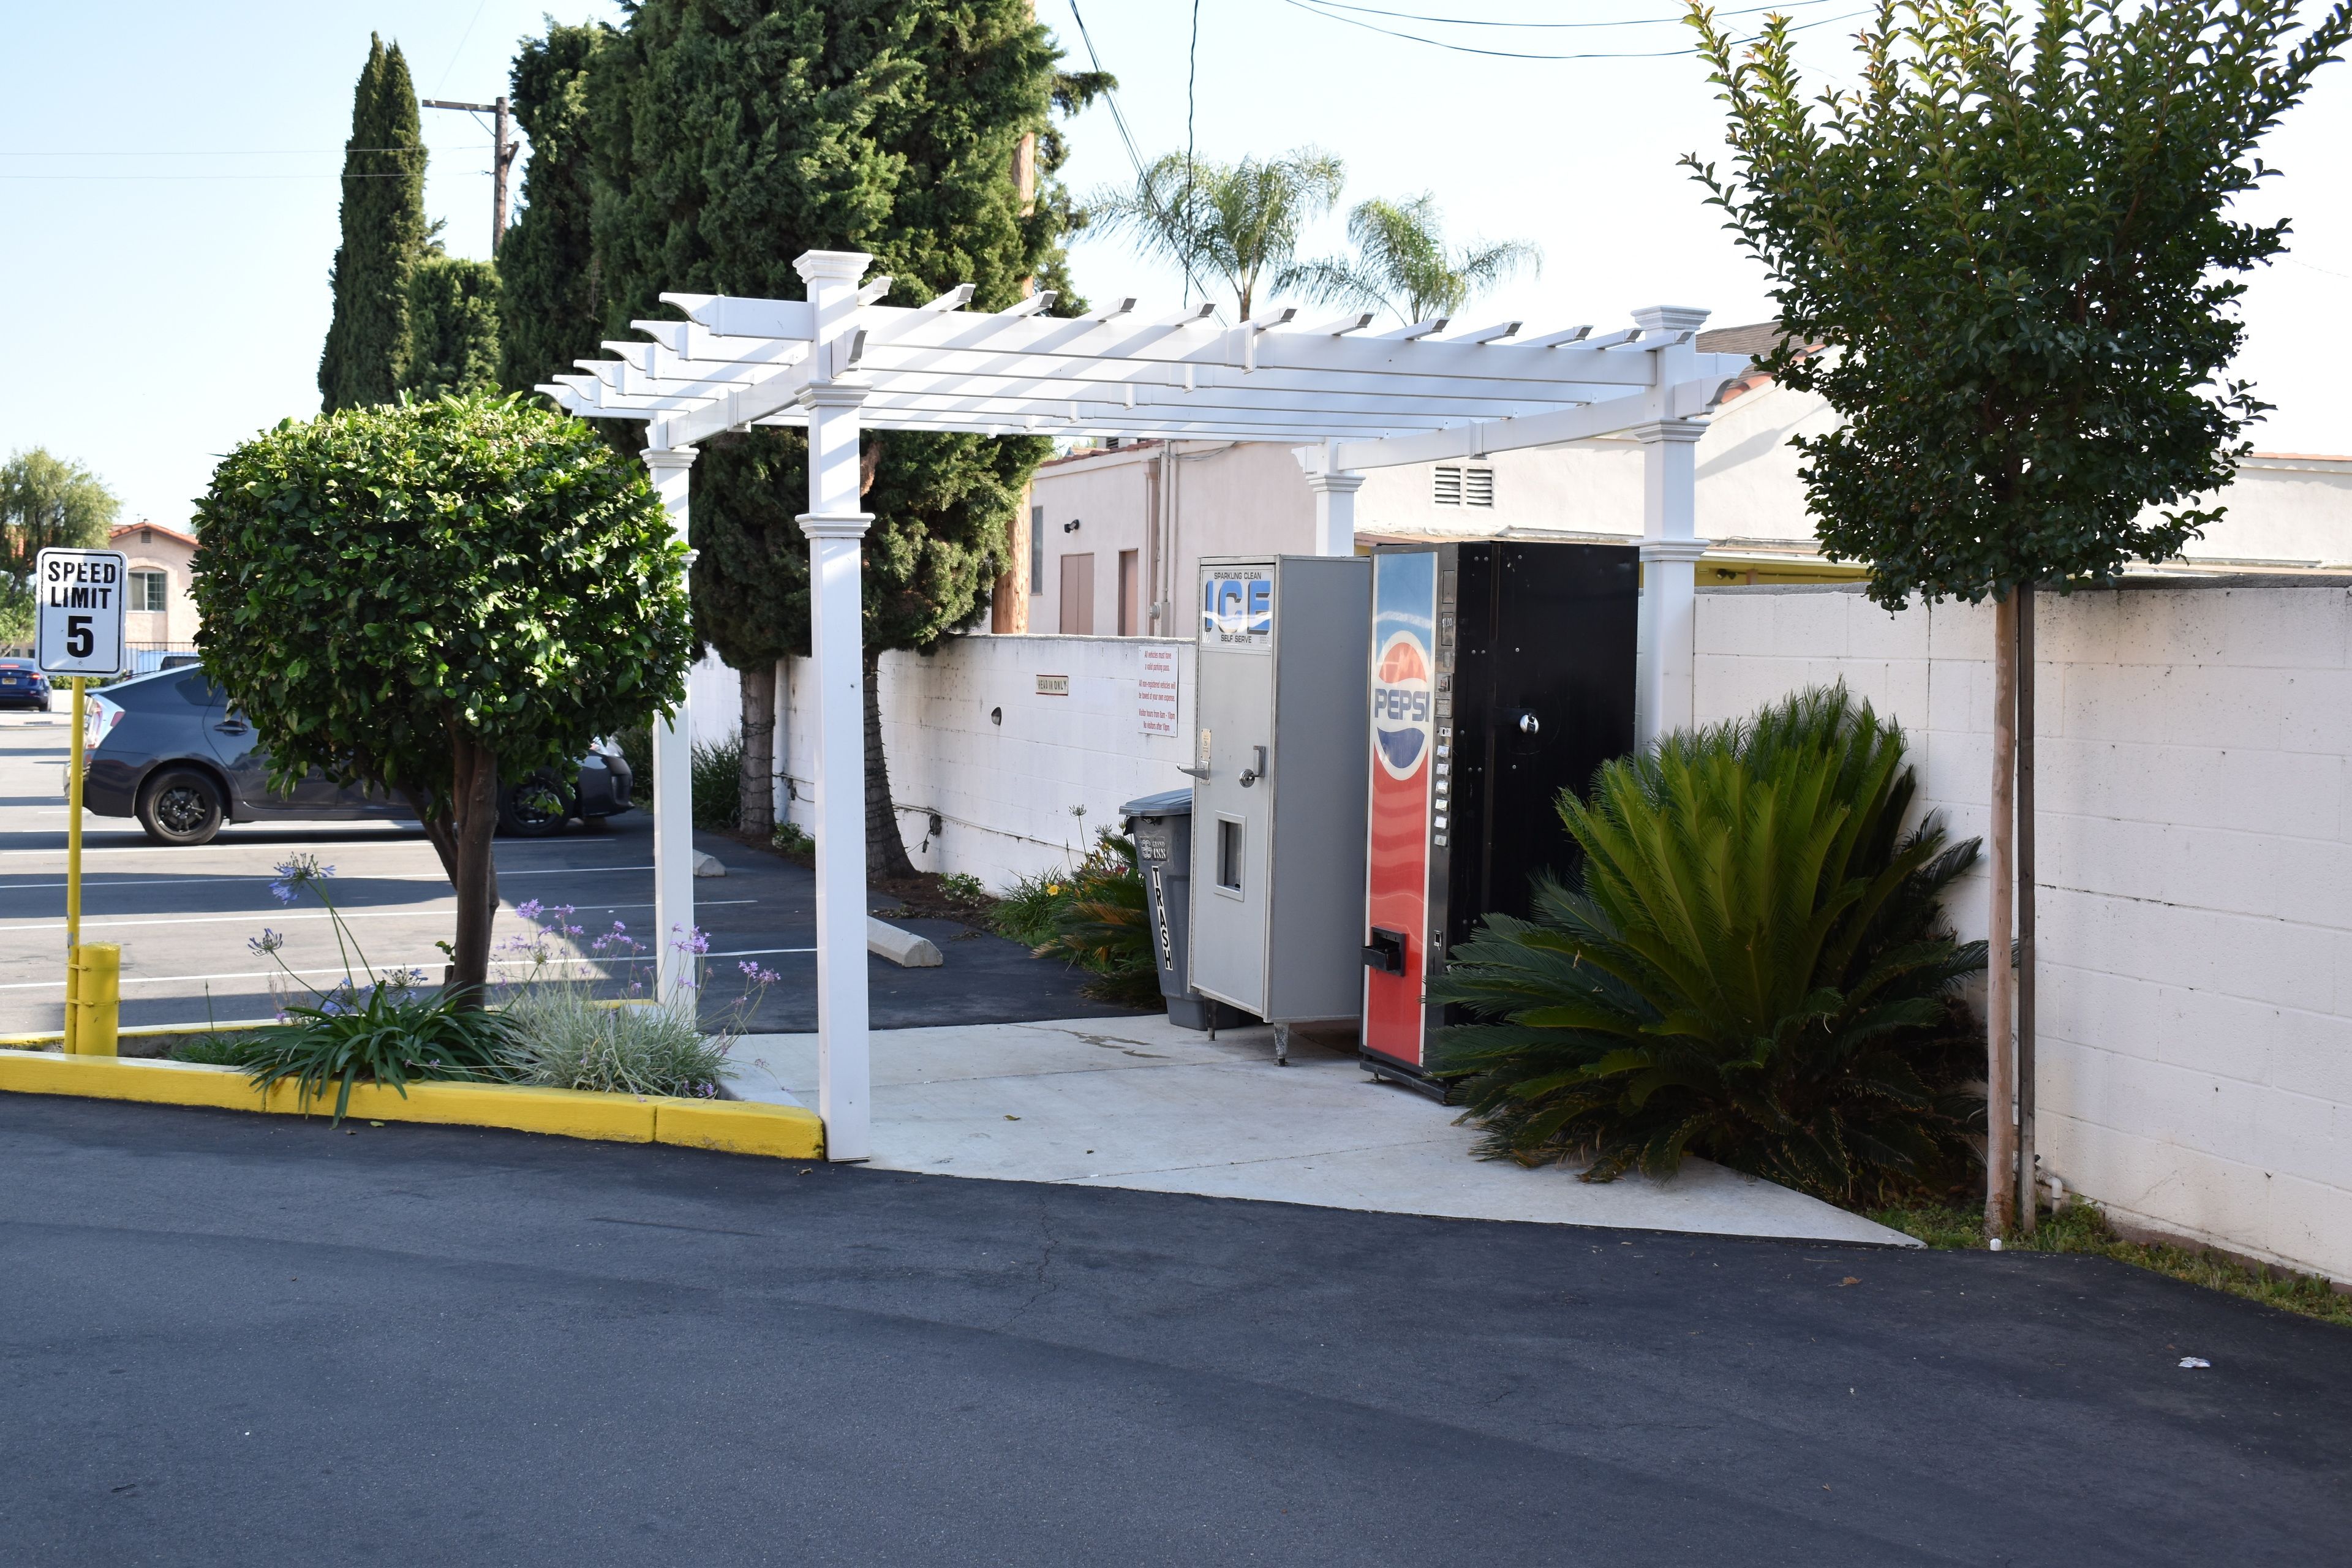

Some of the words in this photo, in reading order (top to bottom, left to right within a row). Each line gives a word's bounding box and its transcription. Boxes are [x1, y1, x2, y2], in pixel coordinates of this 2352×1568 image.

[48, 561, 116, 584] SPEED
[51, 586, 112, 609] LIMIT
[1205, 581, 1270, 635] ICE
[67, 615, 94, 658] 5
[1153, 663, 1163, 673] parking
[1054, 680, 1066, 690] ONLY
[1142, 680, 1159, 689] non-registered
[1374, 688, 1430, 722] PEPSI
[1153, 848, 1166, 858] INN
[1152, 867, 1172, 970] TRASH
